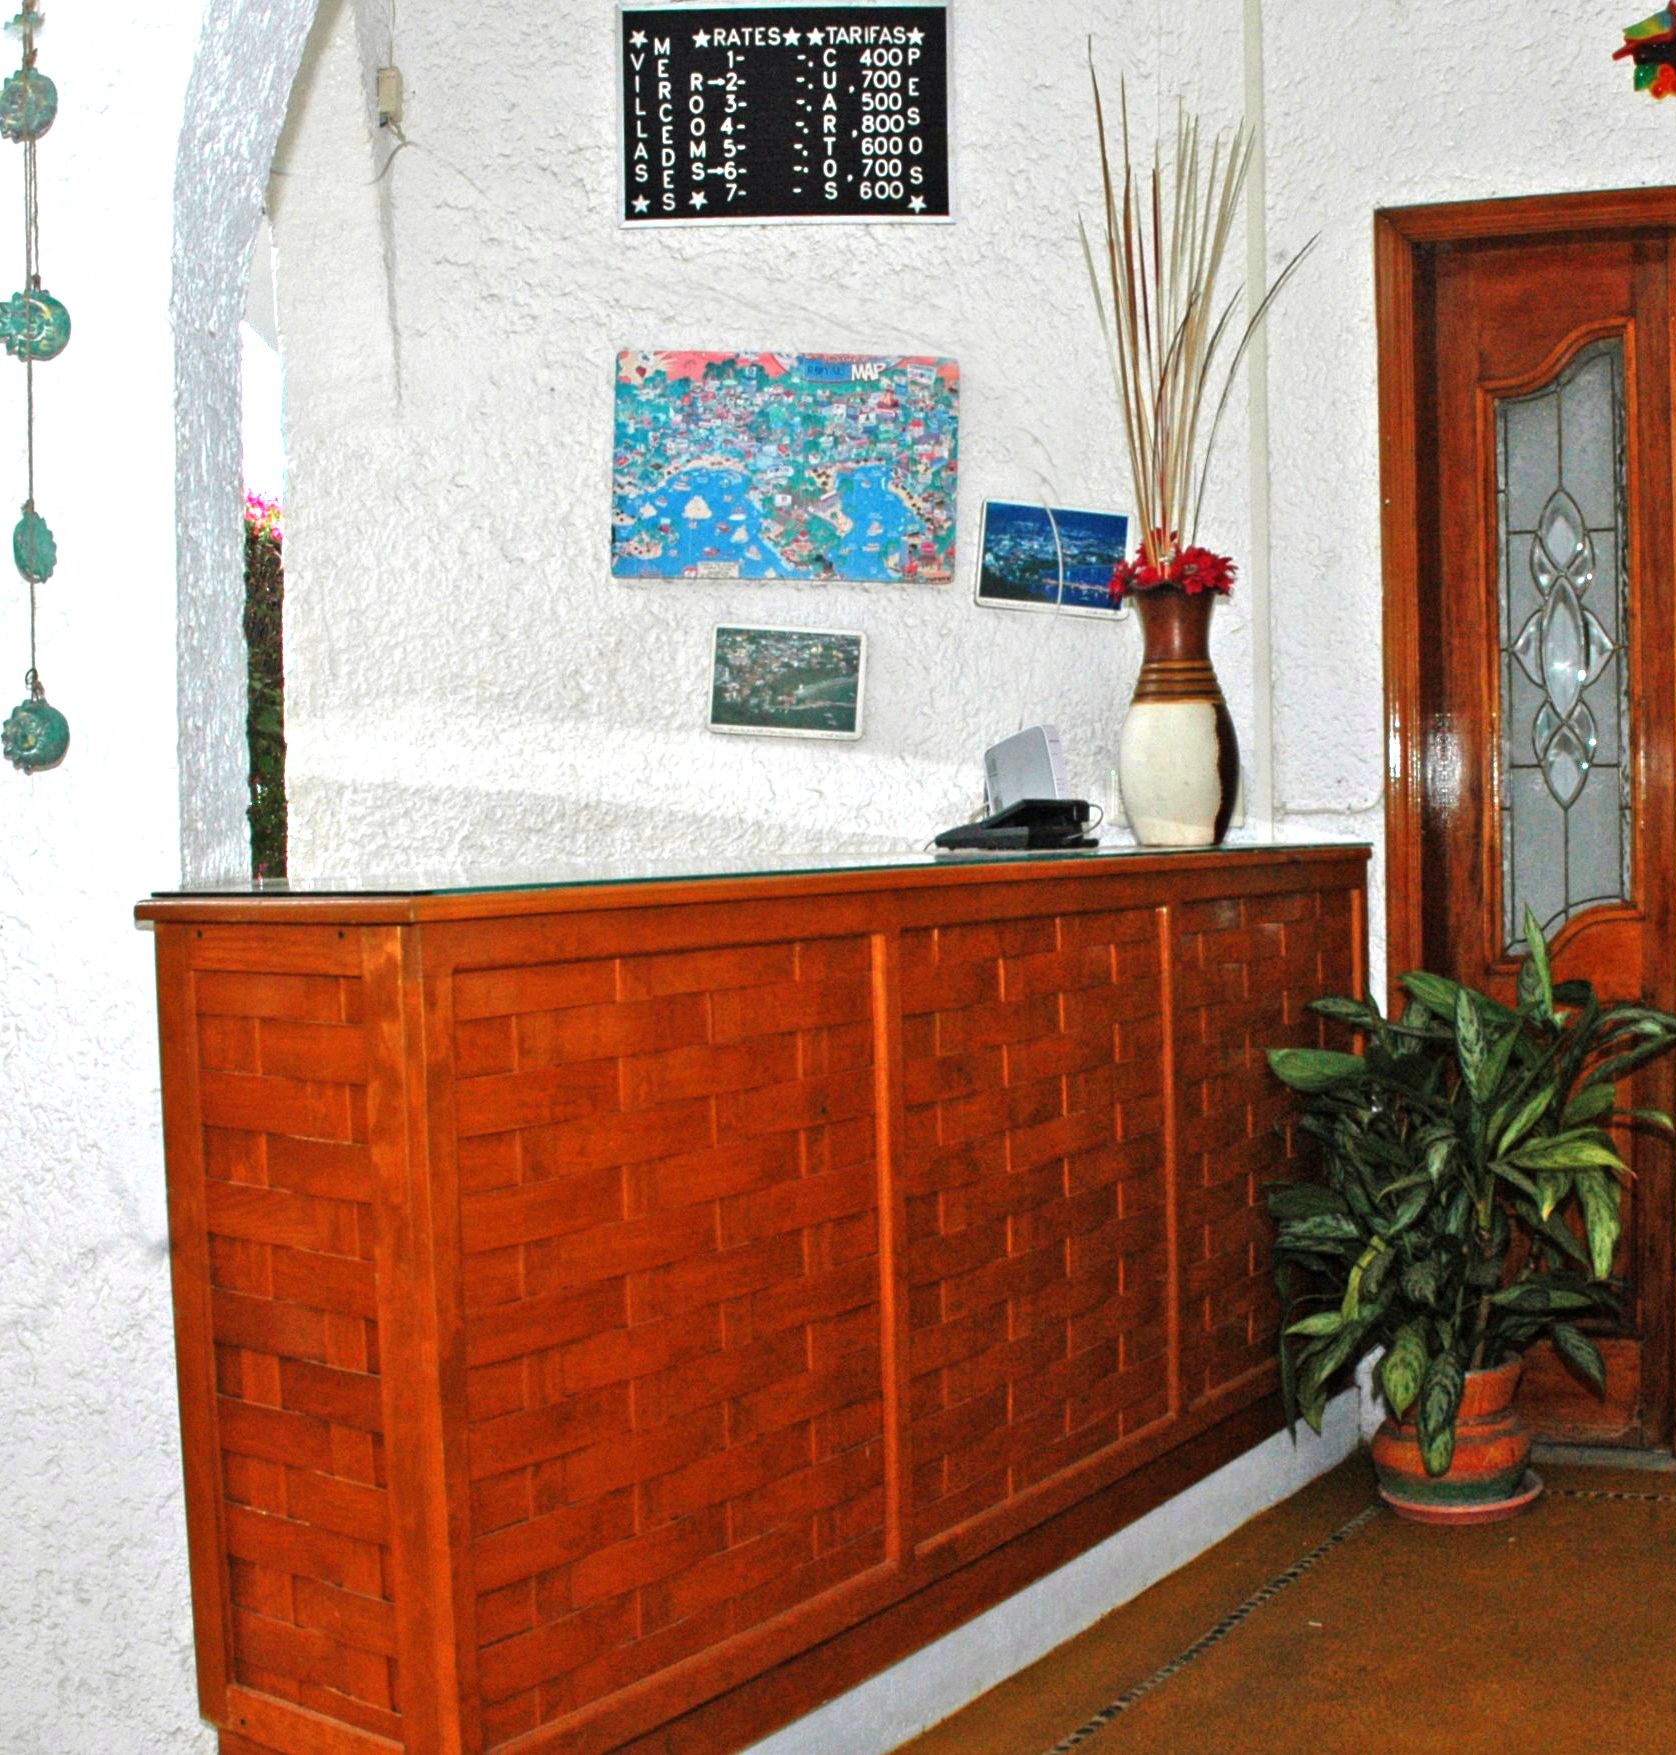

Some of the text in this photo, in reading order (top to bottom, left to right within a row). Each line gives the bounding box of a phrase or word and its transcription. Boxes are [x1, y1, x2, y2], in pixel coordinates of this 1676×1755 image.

[714, 25, 907, 46] RATES TARIFAS
[860, 48, 903, 67] 400
[862, 92, 903, 111] 500
[629, 52, 649, 183] VILLAS
[653, 37, 676, 211] MERCEDES
[823, 47, 838, 201] CUARTOS
[908, 47, 923, 185] PESOS
[688, 73, 707, 181] ROOMS
[862, 136, 903, 155] 600
[860, 181, 904, 200] 600
[851, 361, 887, 382] MAP
